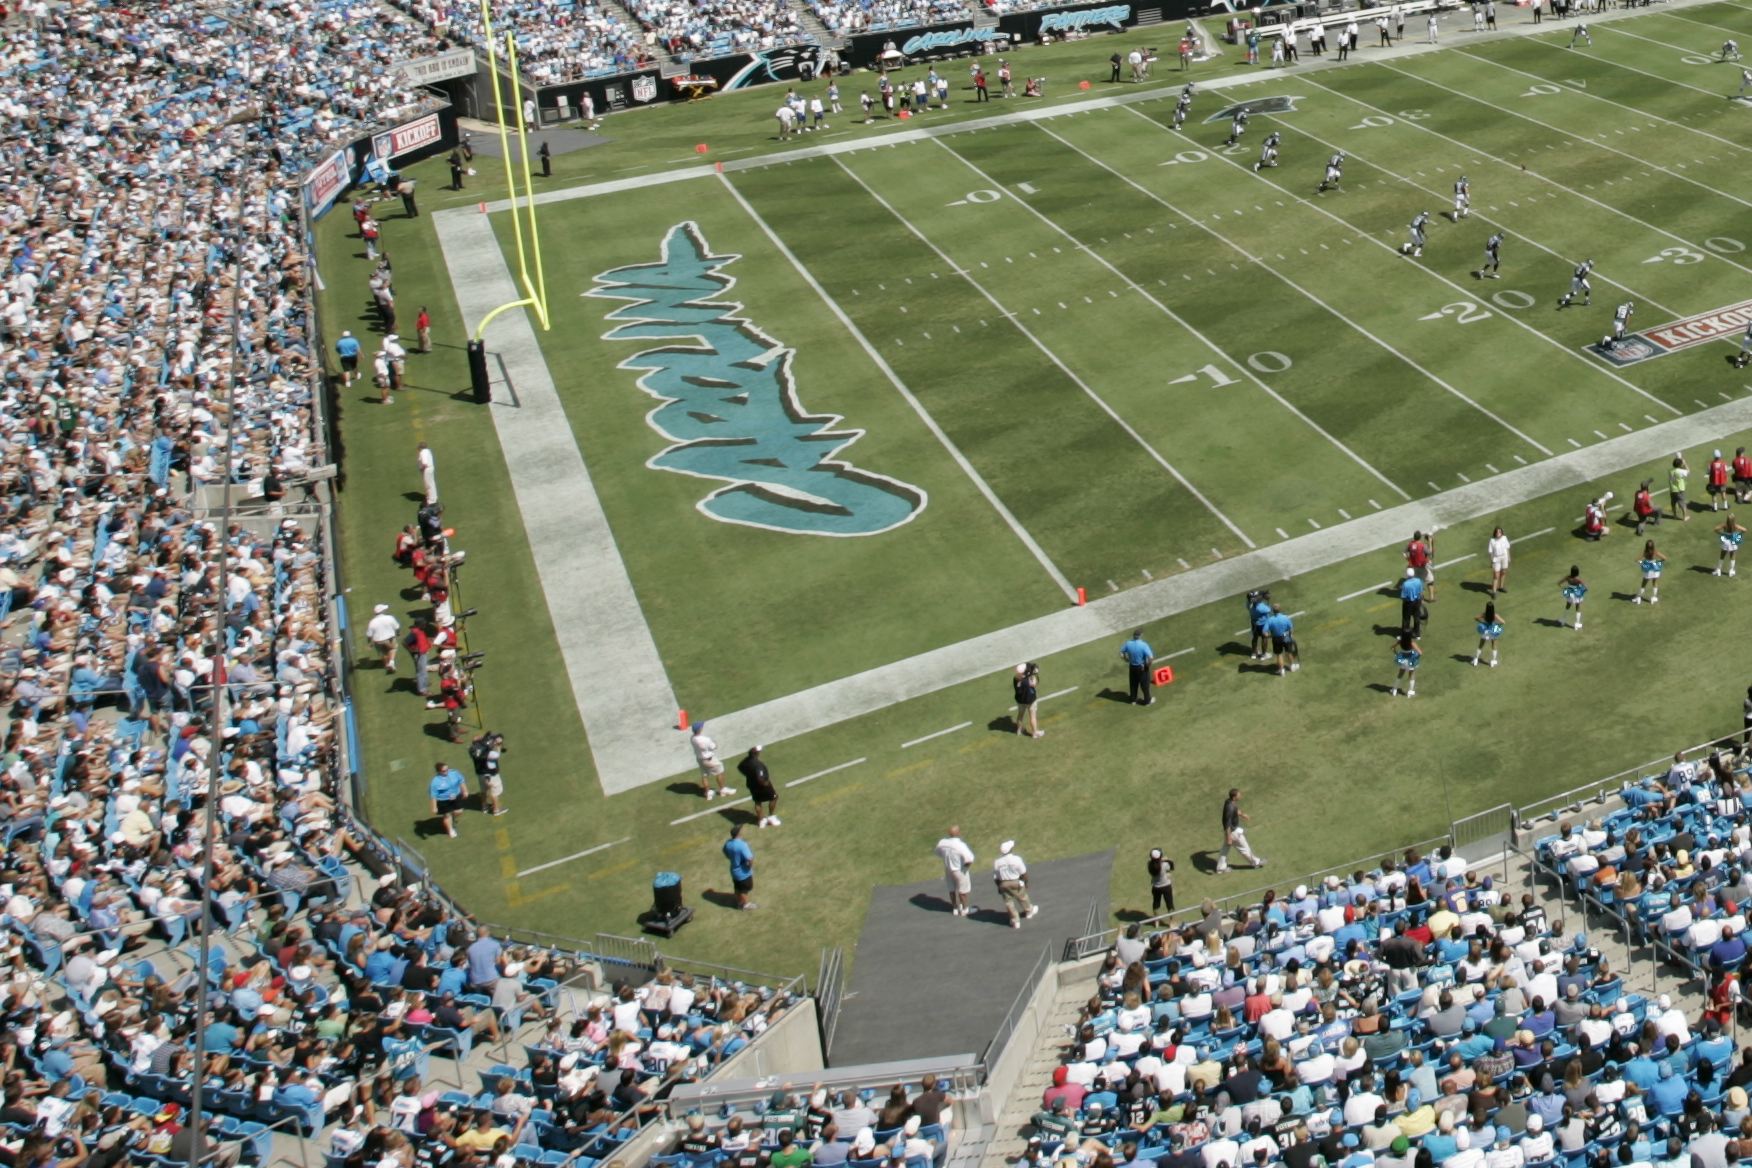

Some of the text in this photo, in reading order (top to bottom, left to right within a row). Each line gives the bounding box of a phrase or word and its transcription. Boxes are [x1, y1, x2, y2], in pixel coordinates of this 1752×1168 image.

[902, 4, 1131, 54] CAROLINA PANTHERS
[395, 120, 437, 150] KICKOFF
[1660, 236, 1747, 265] 30
[1440, 289, 1536, 324] 20
[1195, 350, 1293, 389] 10
[1158, 671, 1170, 683] G
